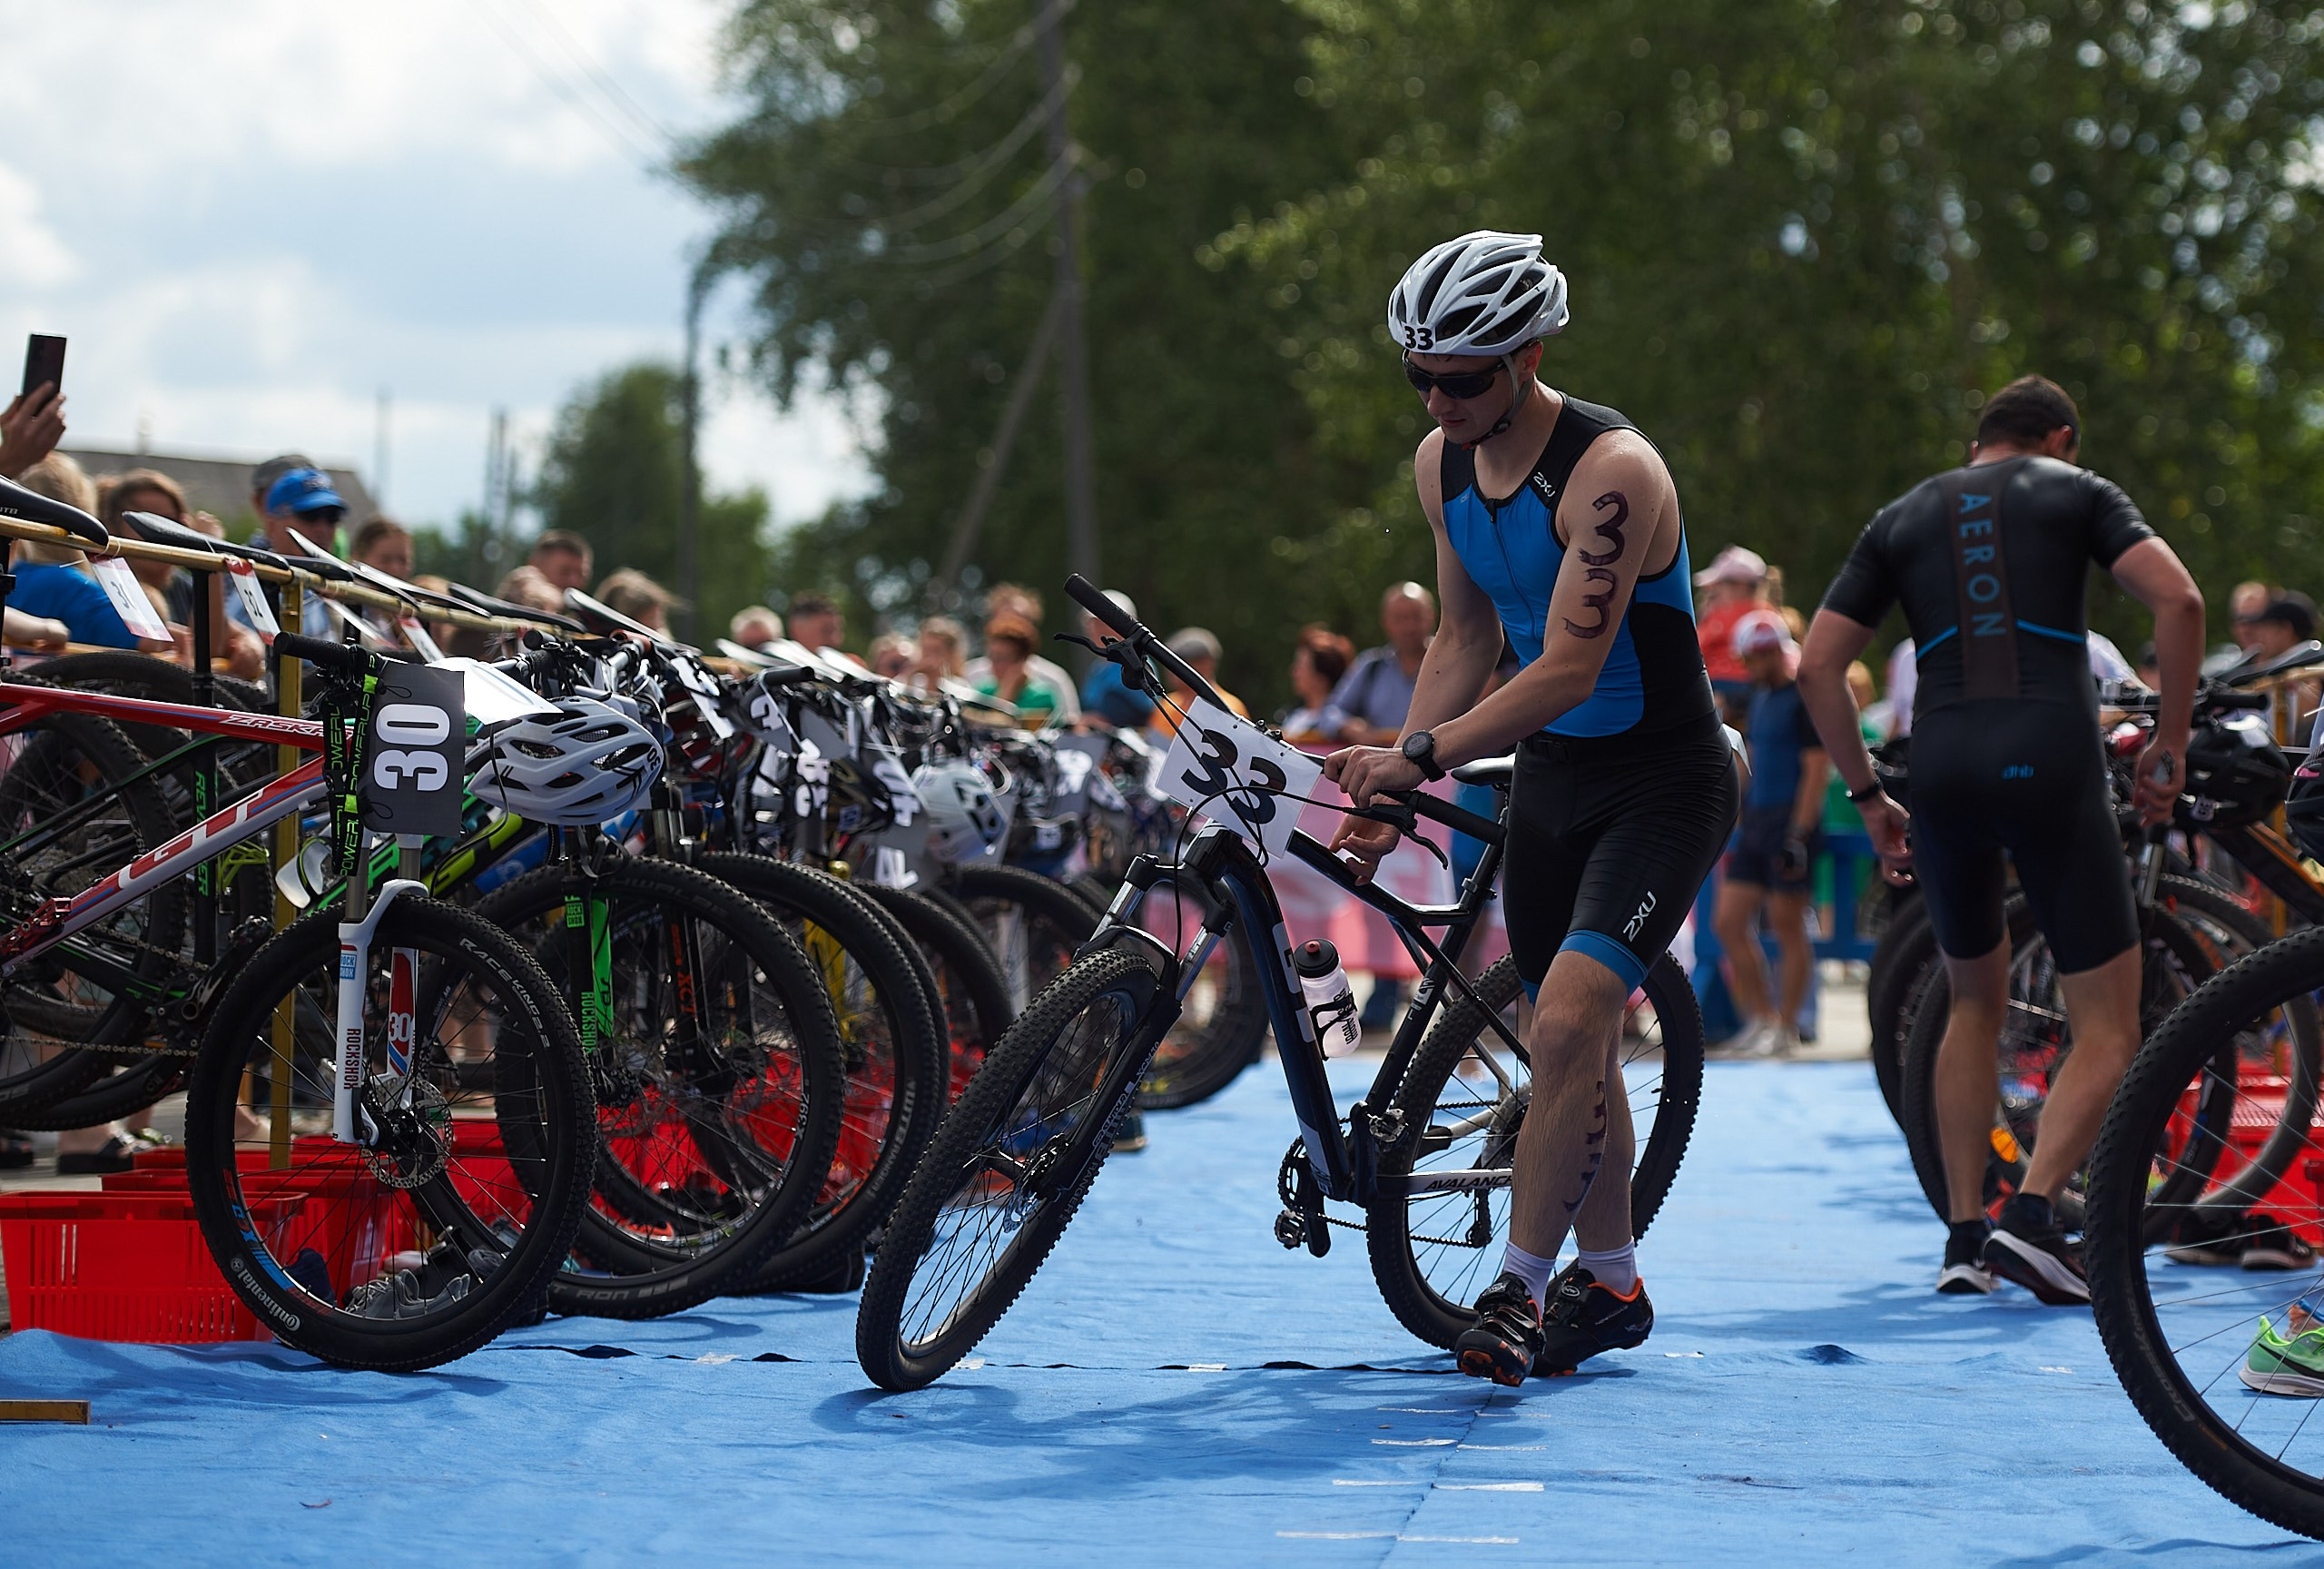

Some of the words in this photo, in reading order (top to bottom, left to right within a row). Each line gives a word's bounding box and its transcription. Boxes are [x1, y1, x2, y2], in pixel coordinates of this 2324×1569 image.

[1404, 325, 1434, 351] 33
[1532, 471, 1556, 498] 2XU
[1959, 492, 2006, 637] AERON
[373, 703, 450, 793] 30
[1181, 727, 1287, 825] 33
[1622, 890, 1657, 942] 2XU
[458, 937, 513, 982] RACE
[512, 979, 540, 1016] KING
[389, 1011, 412, 1042] 30
[343, 1028, 361, 1090] ROCKSHOX
[1423, 1174, 1512, 1191] AVALANCH
[236, 1268, 301, 1332] Continental
